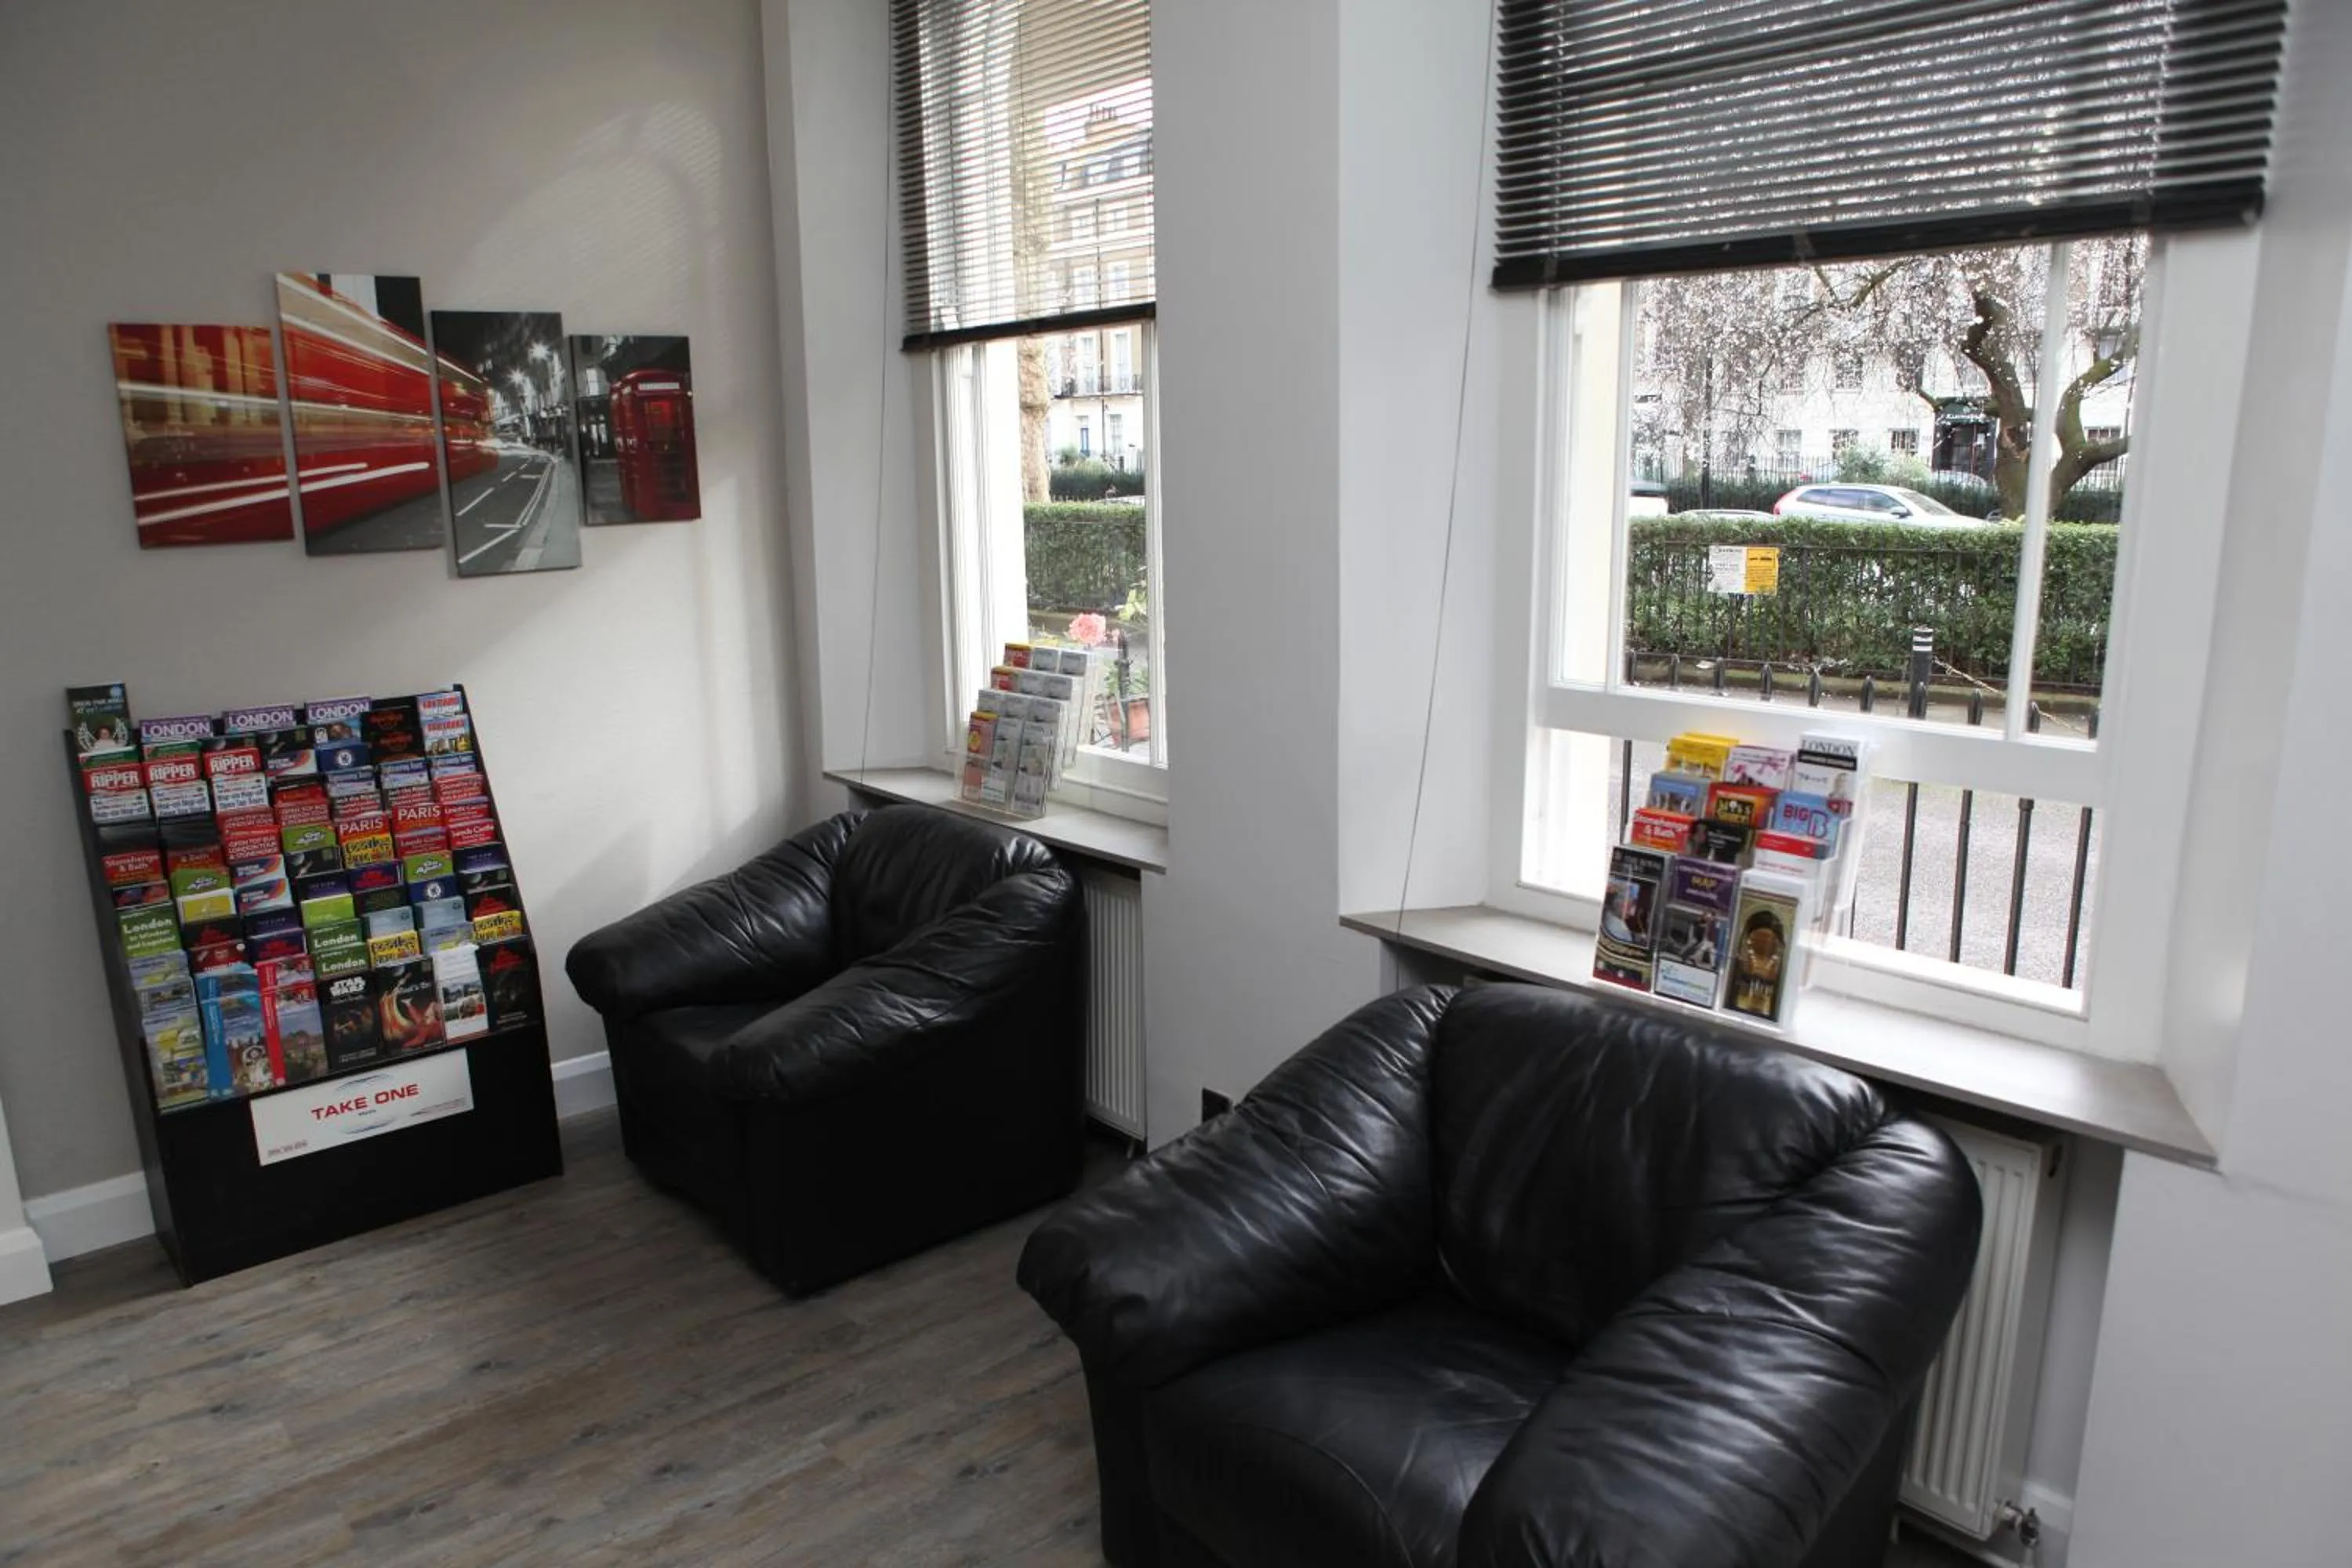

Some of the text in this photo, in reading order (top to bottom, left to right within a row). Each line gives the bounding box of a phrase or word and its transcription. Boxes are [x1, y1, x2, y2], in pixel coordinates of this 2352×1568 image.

[228, 710, 293, 728] LONDON
[309, 702, 370, 720] LONDON
[142, 721, 210, 735] LONDON
[149, 763, 195, 780] RIPPER
[210, 754, 255, 773] RIPPER
[90, 770, 139, 789] RIPPER
[398, 805, 441, 821] PARIS
[1784, 803, 1809, 821] BIG
[339, 818, 383, 835] PARIS
[122, 918, 172, 934] London
[314, 934, 358, 949] London
[322, 958, 366, 972] London
[311, 1084, 419, 1120] TAKE ONE
